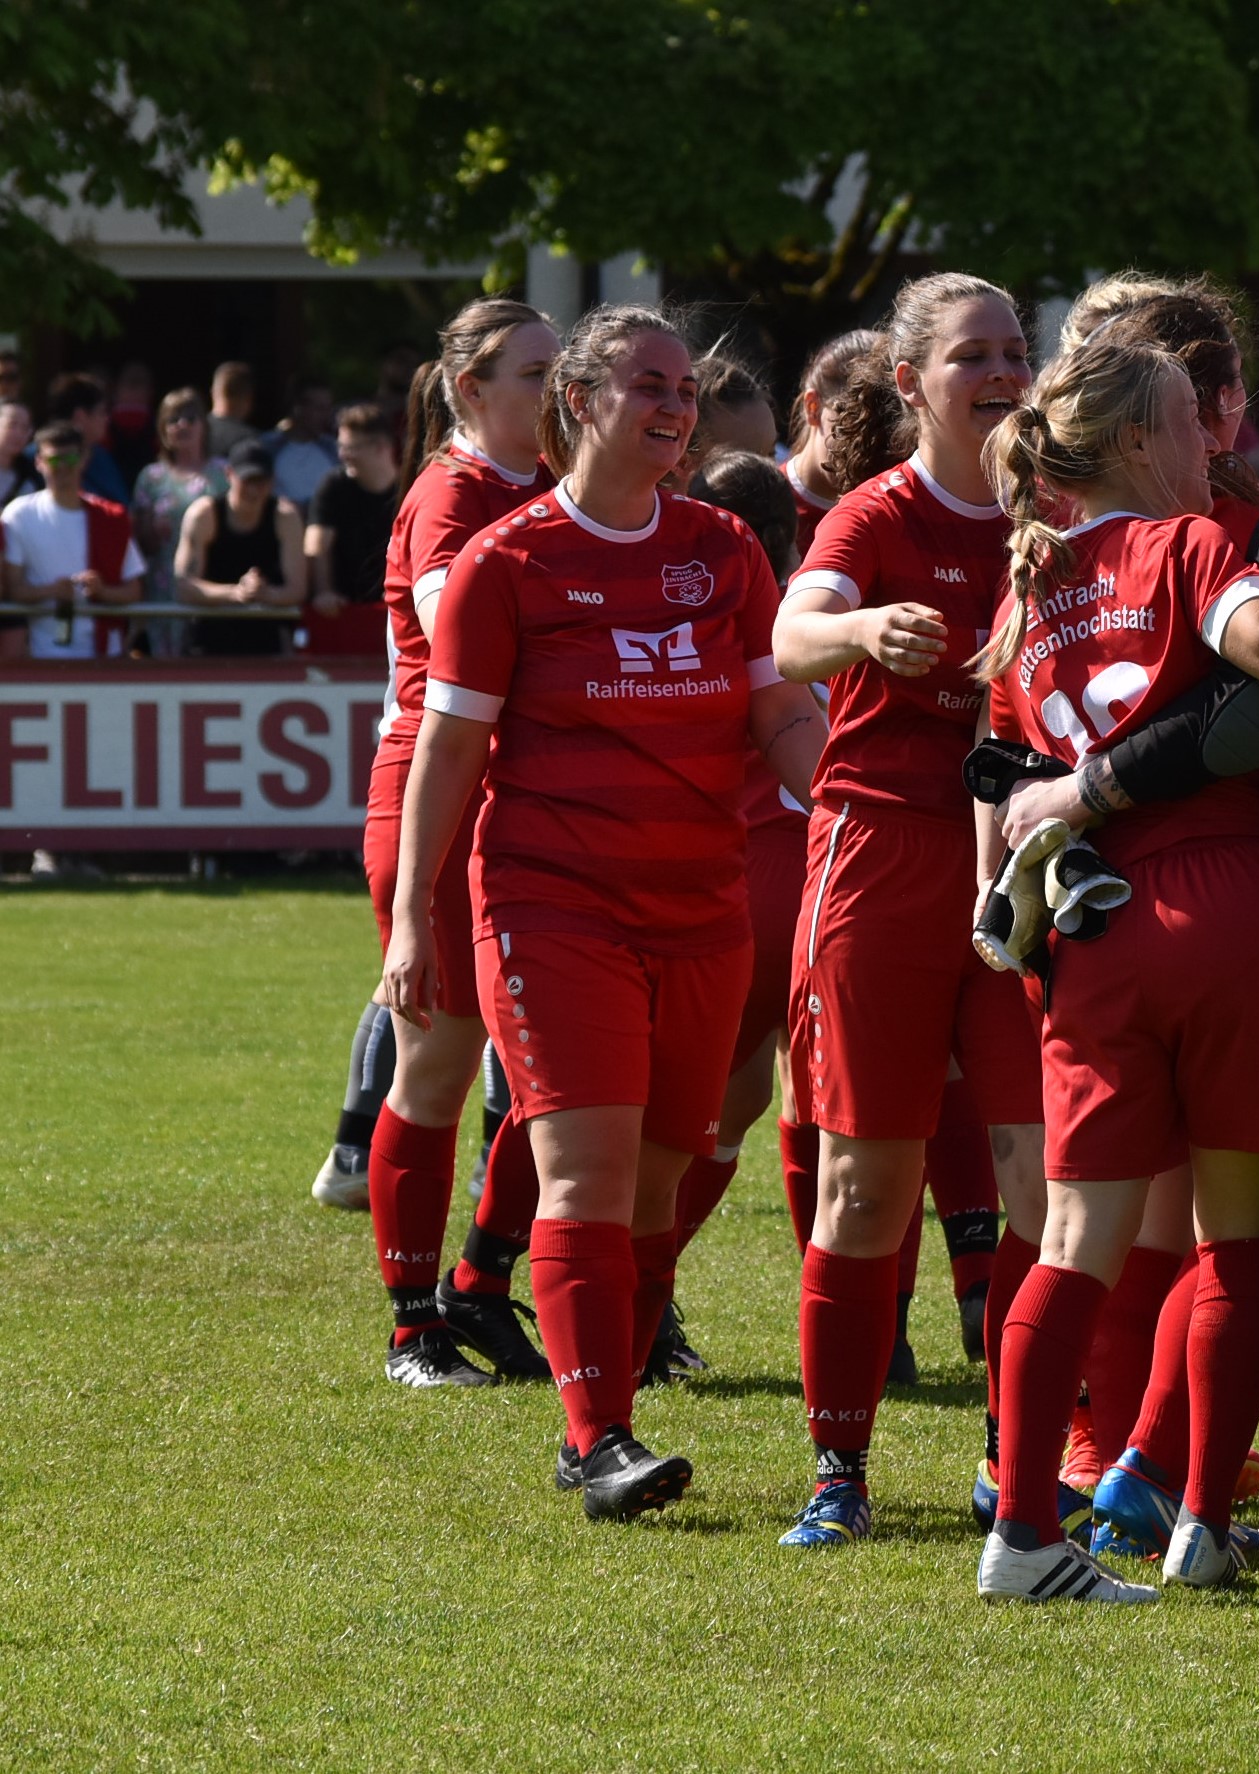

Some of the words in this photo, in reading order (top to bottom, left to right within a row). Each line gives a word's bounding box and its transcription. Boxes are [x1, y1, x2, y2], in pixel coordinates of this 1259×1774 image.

[567, 590, 604, 605] JAKO
[1026, 571, 1115, 633] Eintracht
[586, 675, 731, 699] Raiffeisenbank
[384, 1249, 437, 1263] JAKO
[405, 1296, 436, 1311] JAKO
[555, 1366, 601, 1392] JAKO
[807, 1407, 867, 1422] JAKO
